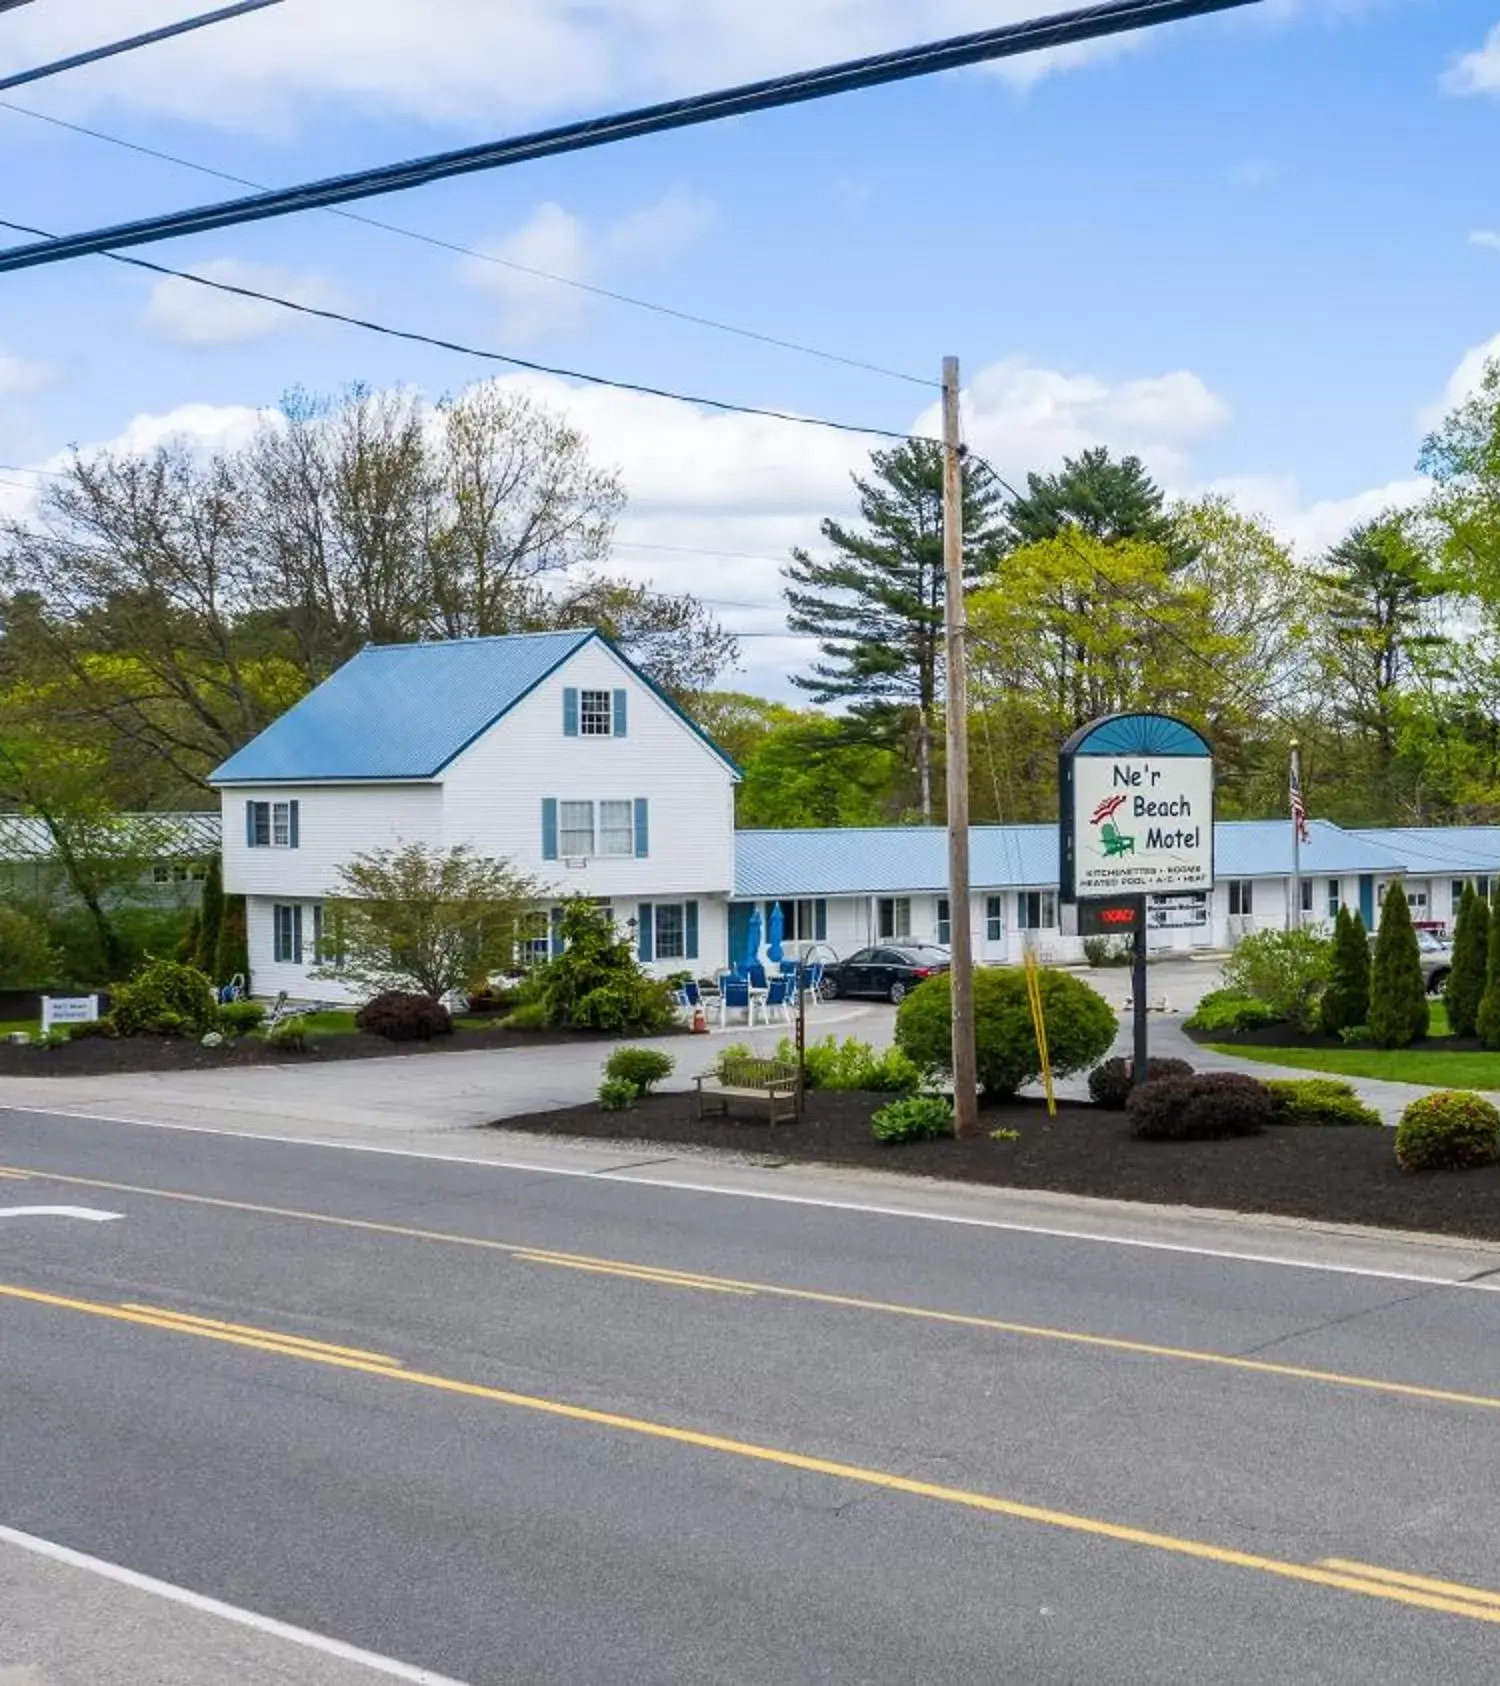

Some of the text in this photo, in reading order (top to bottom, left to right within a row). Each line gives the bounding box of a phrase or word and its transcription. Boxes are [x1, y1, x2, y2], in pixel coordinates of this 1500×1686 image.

[1113, 764, 1160, 787] Ne'r
[1133, 794, 1191, 817] Beach
[1146, 826, 1200, 849] Motel
